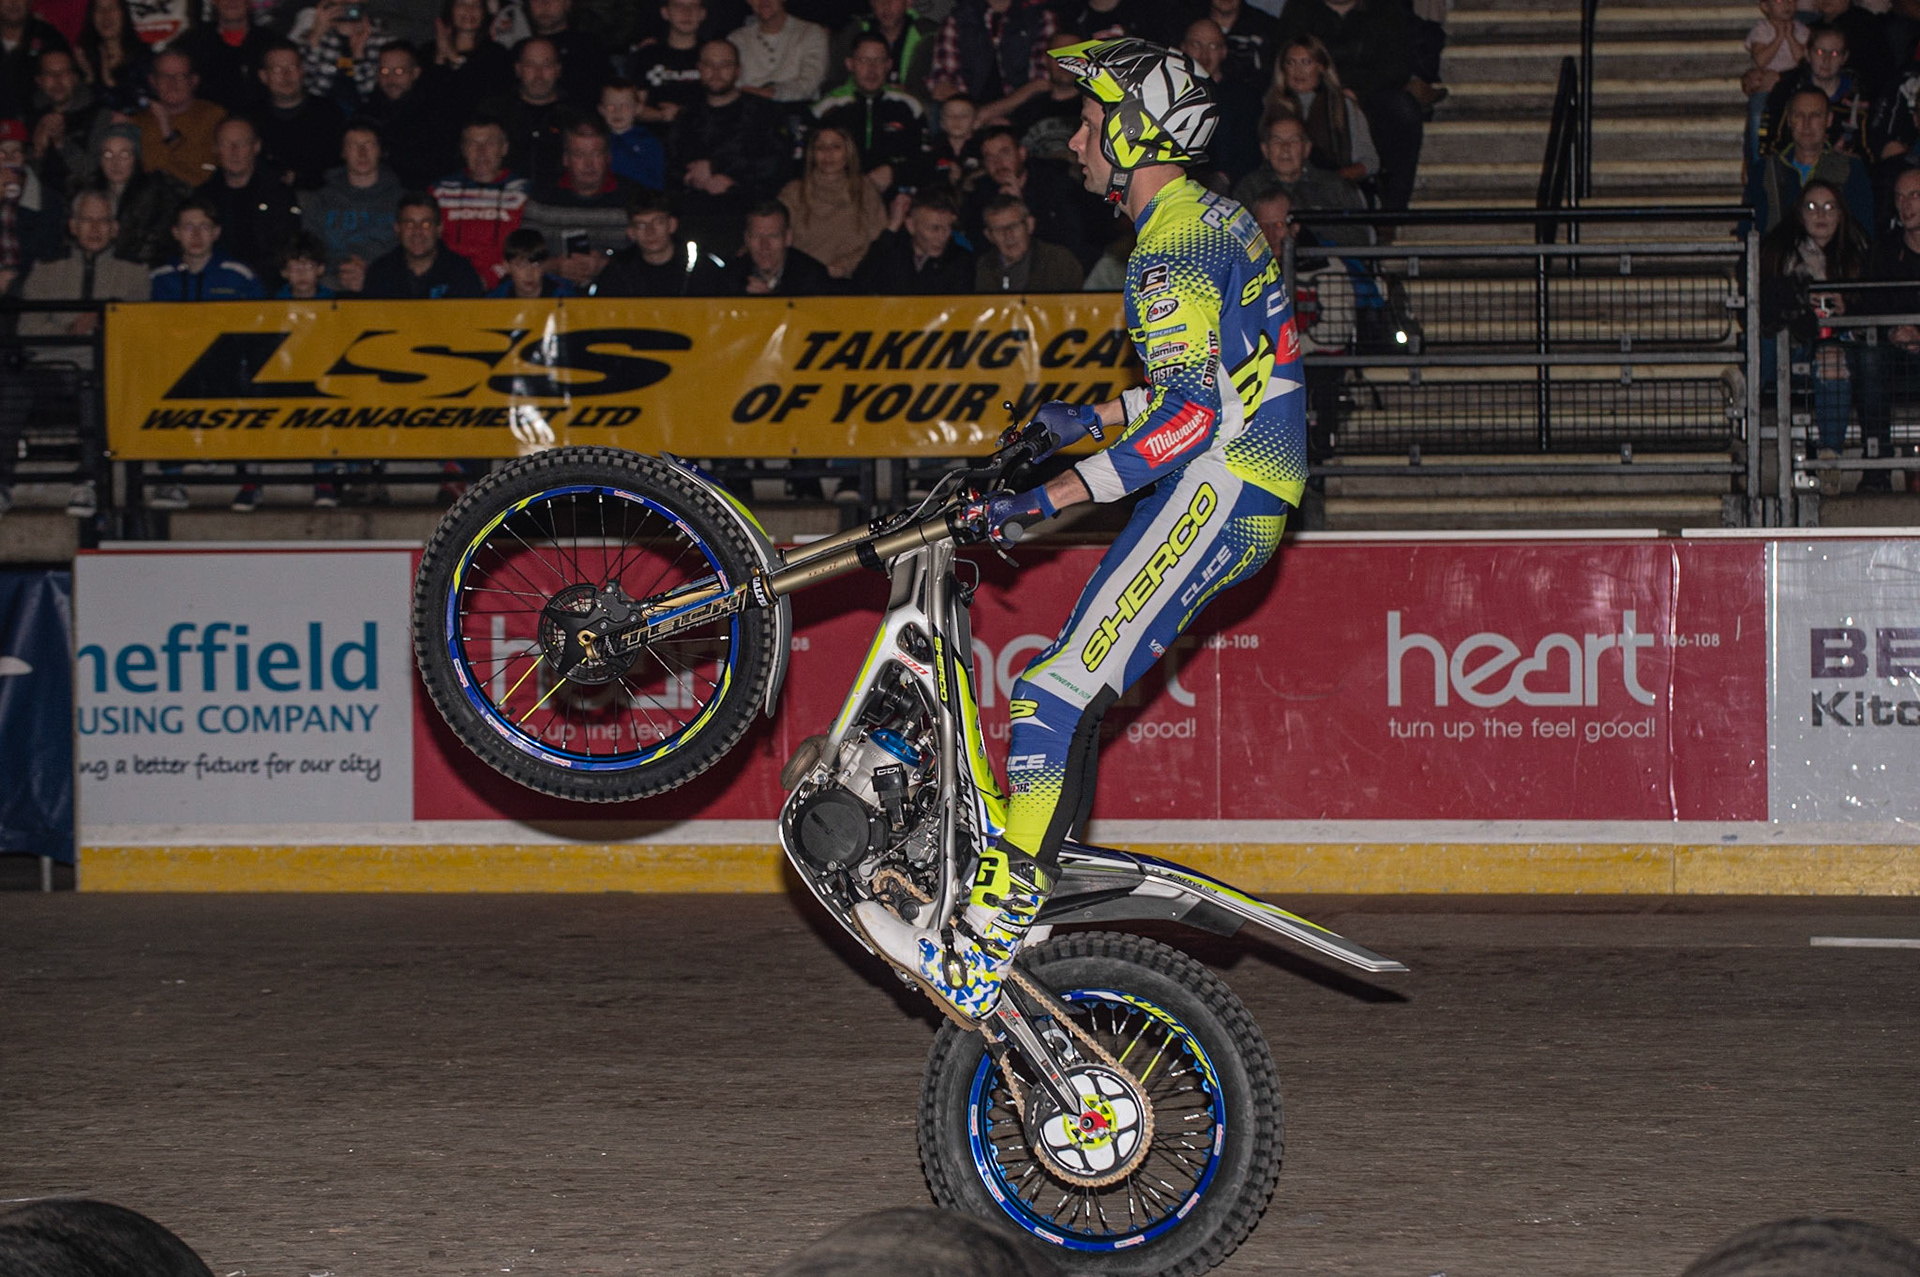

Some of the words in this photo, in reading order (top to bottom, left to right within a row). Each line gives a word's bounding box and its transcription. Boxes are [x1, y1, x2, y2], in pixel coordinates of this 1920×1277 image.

[161, 328, 693, 399] LSS
[795, 330, 1028, 370] TAKING
[141, 407, 280, 430] WASTE
[283, 406, 572, 429] MANAGEMENT
[568, 406, 643, 427] LTD
[731, 383, 822, 424] OF
[832, 382, 1001, 424] YOUR
[1081, 482, 1217, 673] SHERCO
[1181, 544, 1233, 607] CLICE
[1662, 633, 1720, 648] 106-108
[934, 636, 948, 702] SHERCO
[1387, 609, 1655, 707] heart
[1048, 672, 1079, 694] MINERVA
[197, 704, 379, 734] COMPANY
[1126, 718, 1197, 744] good!
[1388, 718, 1435, 739] turn
[1443, 721, 1475, 742] up
[1482, 718, 1523, 738] the
[1532, 717, 1576, 738] feel
[1585, 717, 1656, 744] good!
[115, 759, 127, 774] a
[133, 755, 190, 774] better
[194, 753, 260, 780] future
[267, 753, 296, 780] for
[300, 759, 335, 774] our
[340, 753, 382, 783] city
[876, 766, 900, 776] CDI
